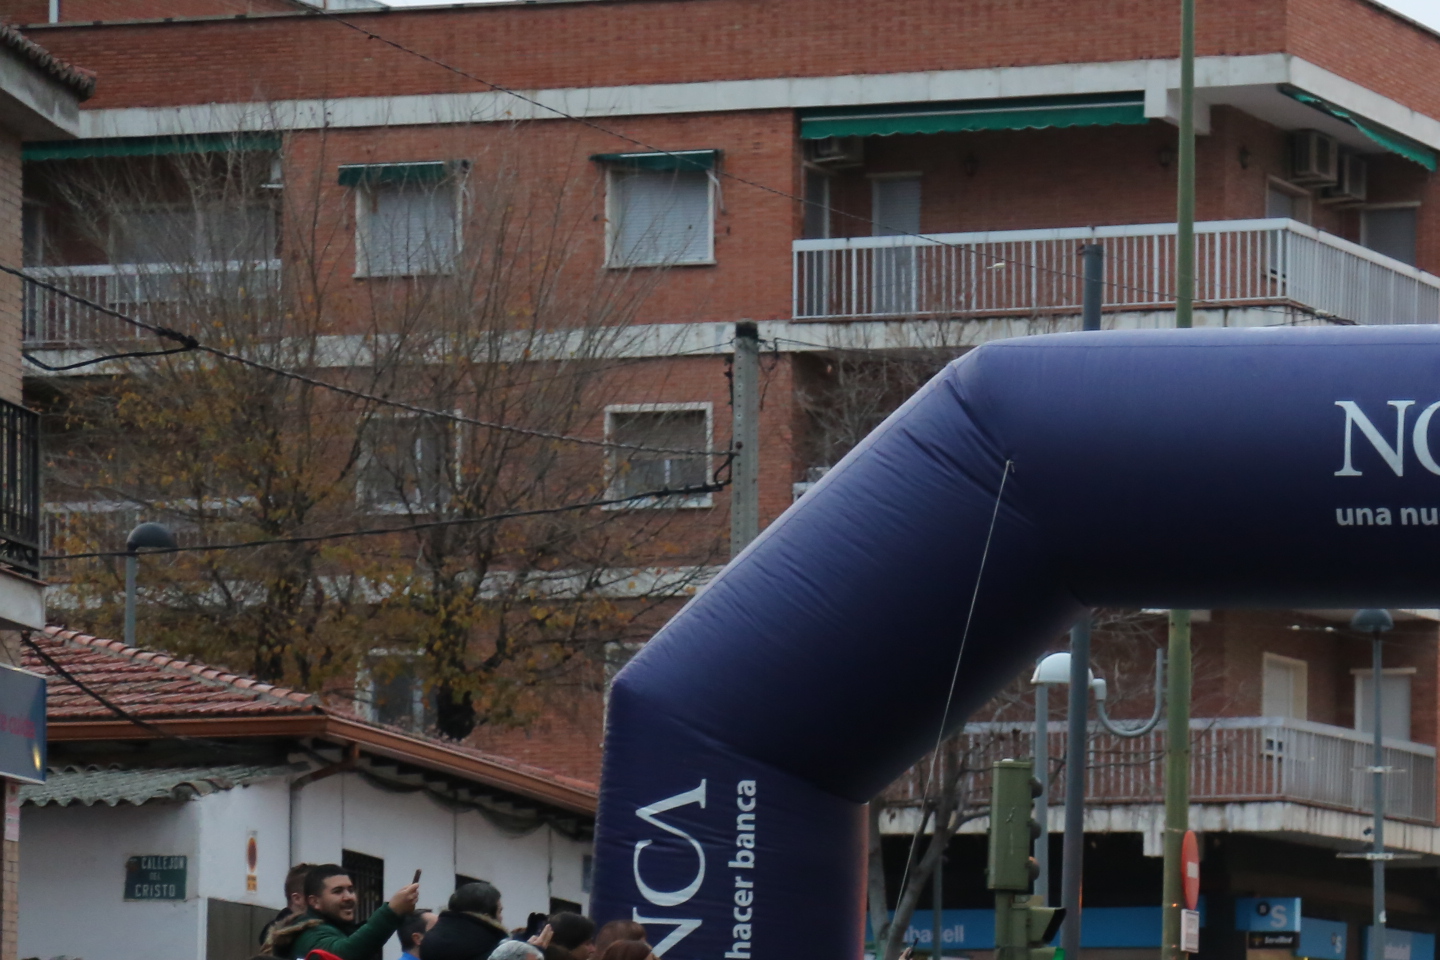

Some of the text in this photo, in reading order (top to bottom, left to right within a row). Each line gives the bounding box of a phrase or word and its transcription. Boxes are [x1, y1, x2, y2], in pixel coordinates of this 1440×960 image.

[1336, 507, 1392, 526] una
[728, 779, 757, 868] banca
[135, 884, 176, 898] CRISTO
[724, 876, 754, 959] hacer
